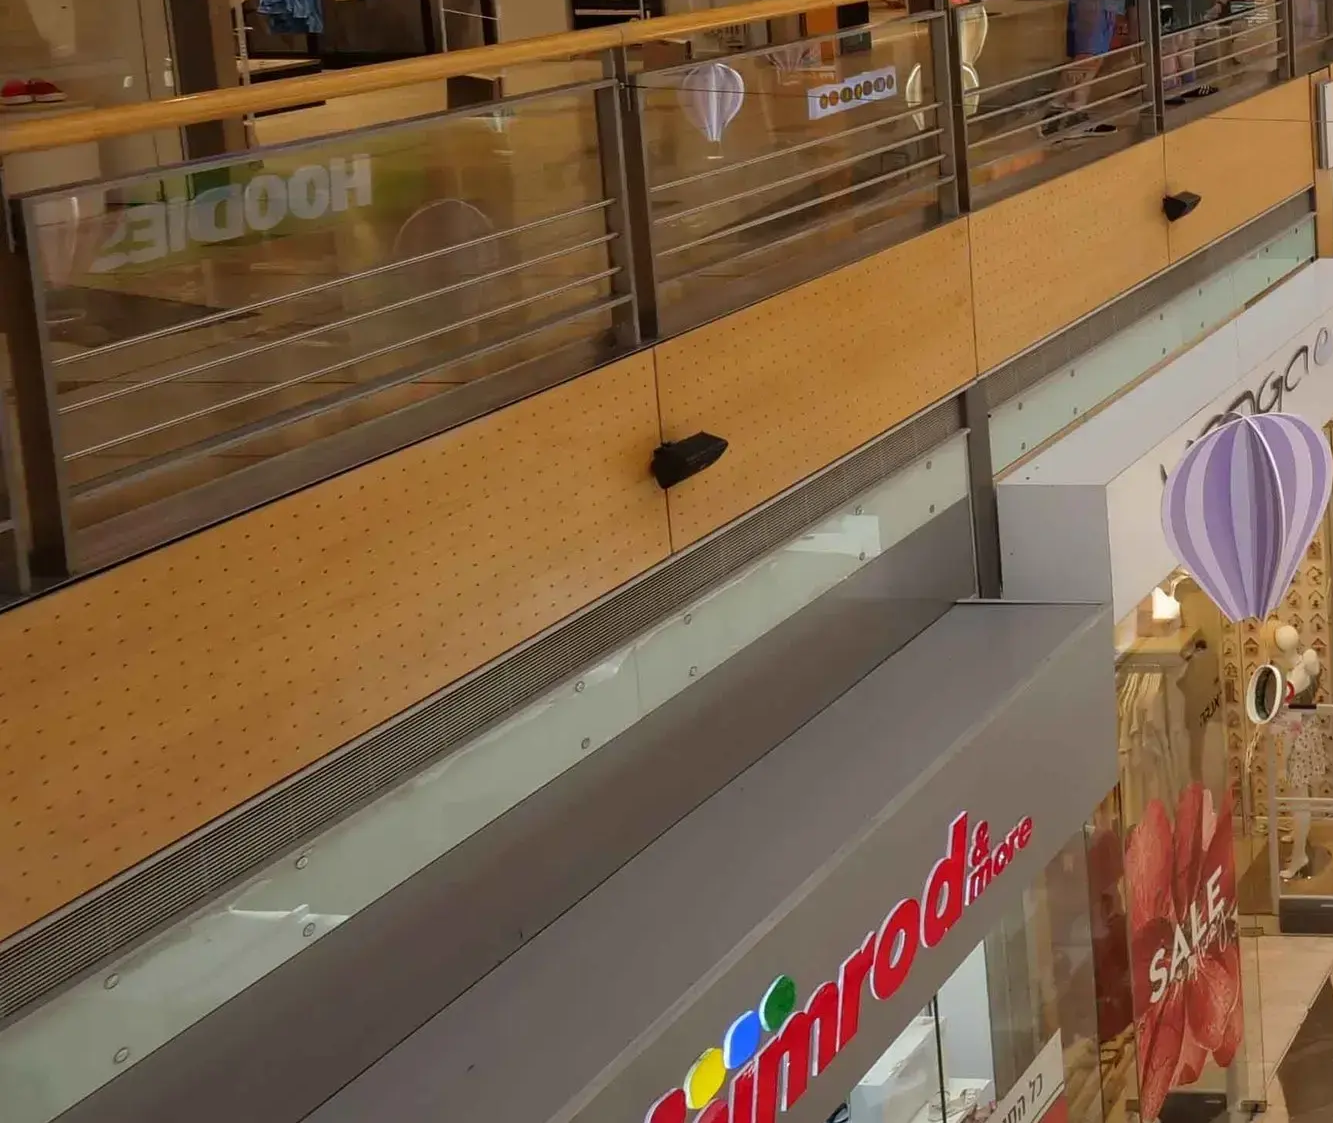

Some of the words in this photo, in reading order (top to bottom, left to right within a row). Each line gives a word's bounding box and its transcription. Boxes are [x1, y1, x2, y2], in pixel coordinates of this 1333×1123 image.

[965, 815, 1033, 906] more
[1149, 864, 1226, 1004] SALE
[1028, 1072, 1043, 1104] כל
